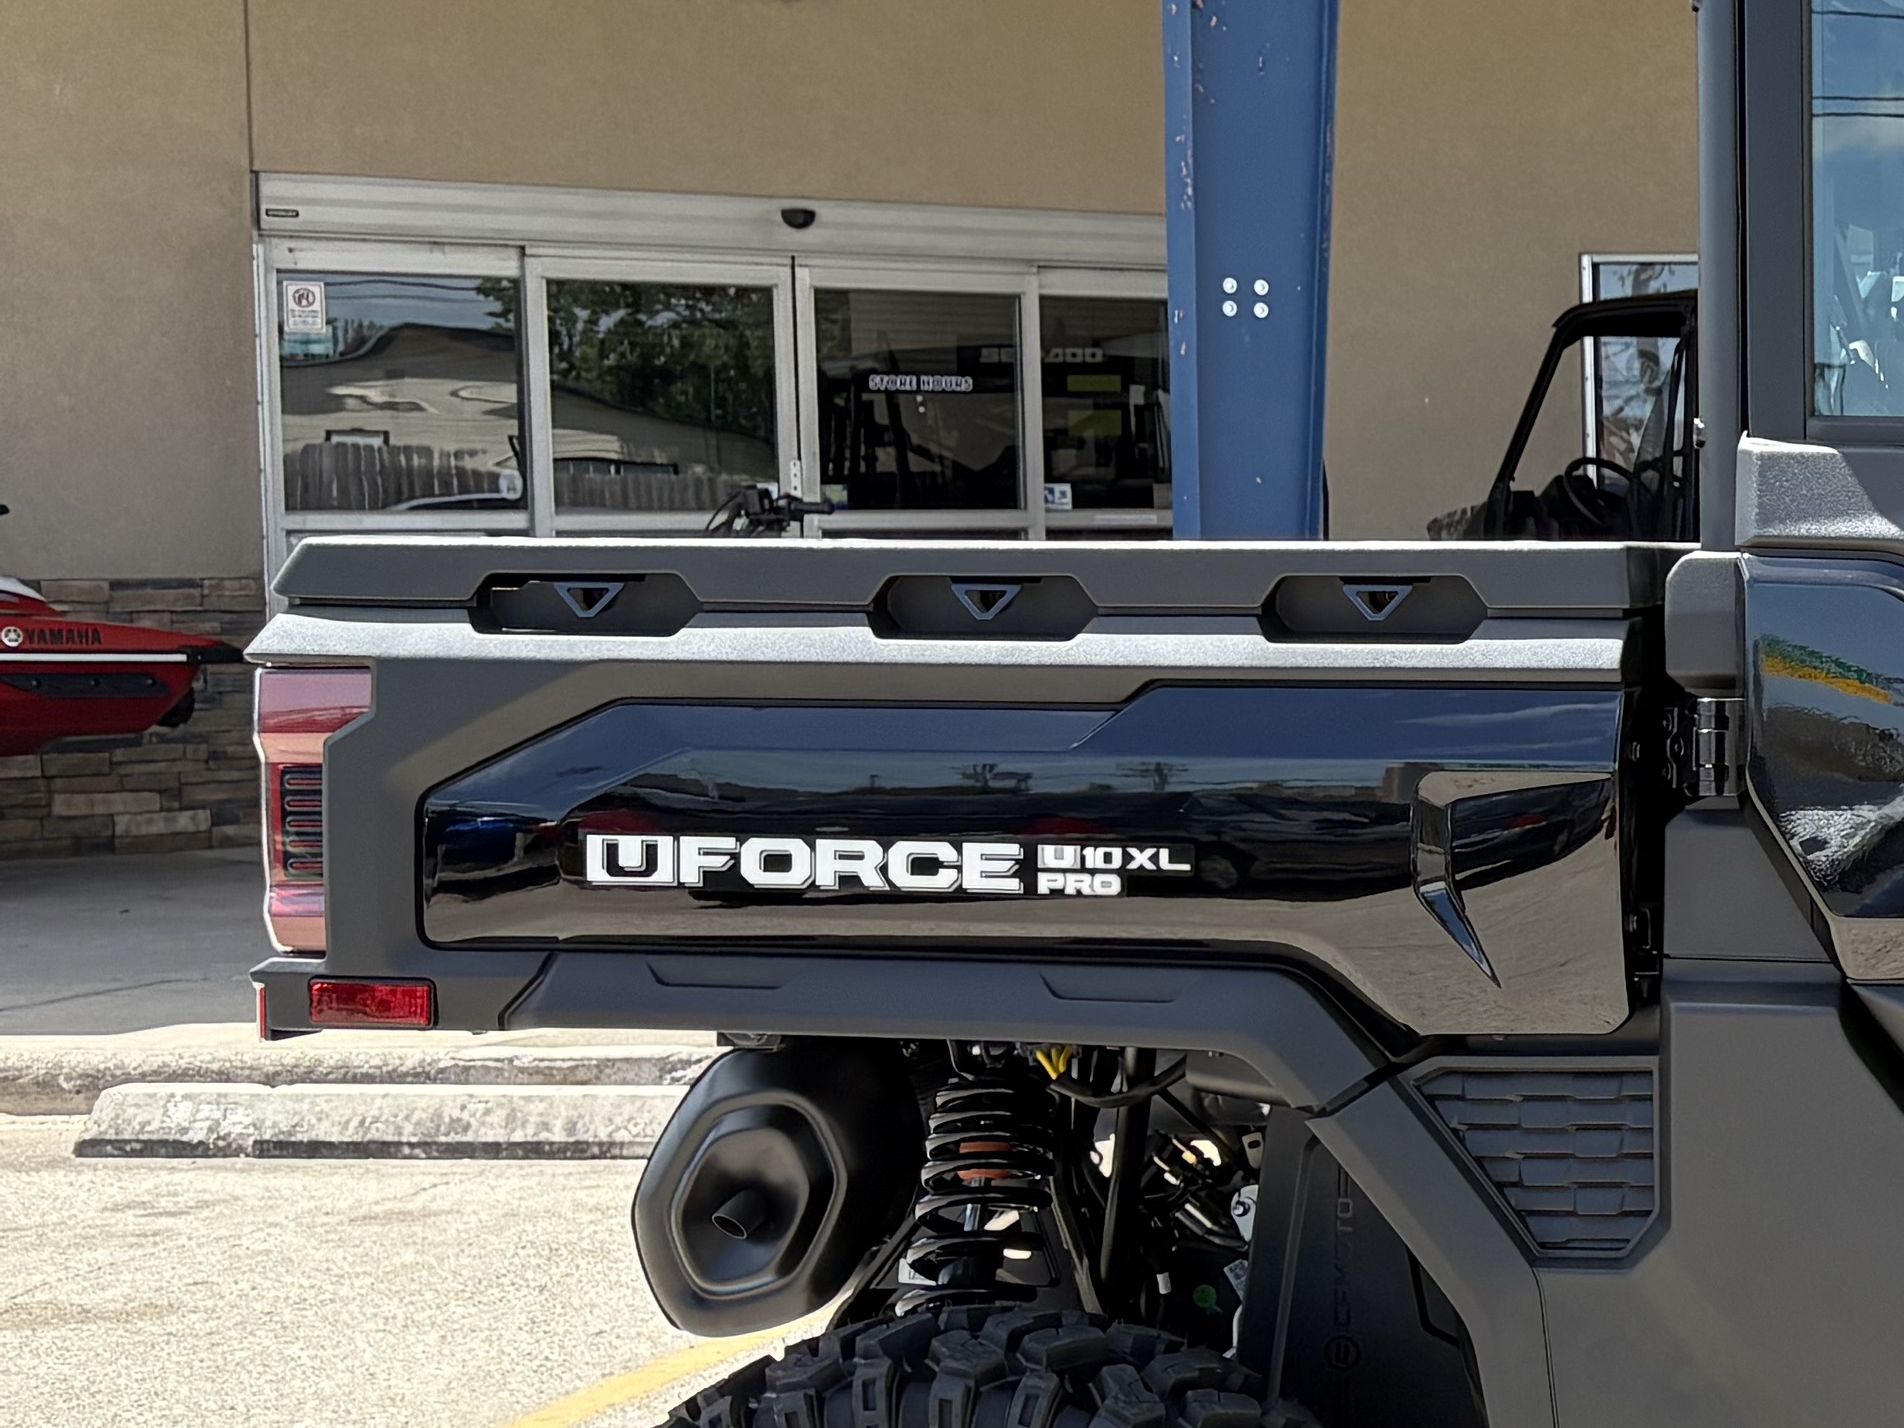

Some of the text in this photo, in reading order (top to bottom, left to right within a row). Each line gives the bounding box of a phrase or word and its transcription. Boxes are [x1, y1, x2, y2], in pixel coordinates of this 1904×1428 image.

[869, 374, 973, 391] STORE HOURS
[25, 627, 102, 645] YAMAHA
[584, 833, 1024, 895] UFORCE
[1037, 872, 1122, 896] PRO
